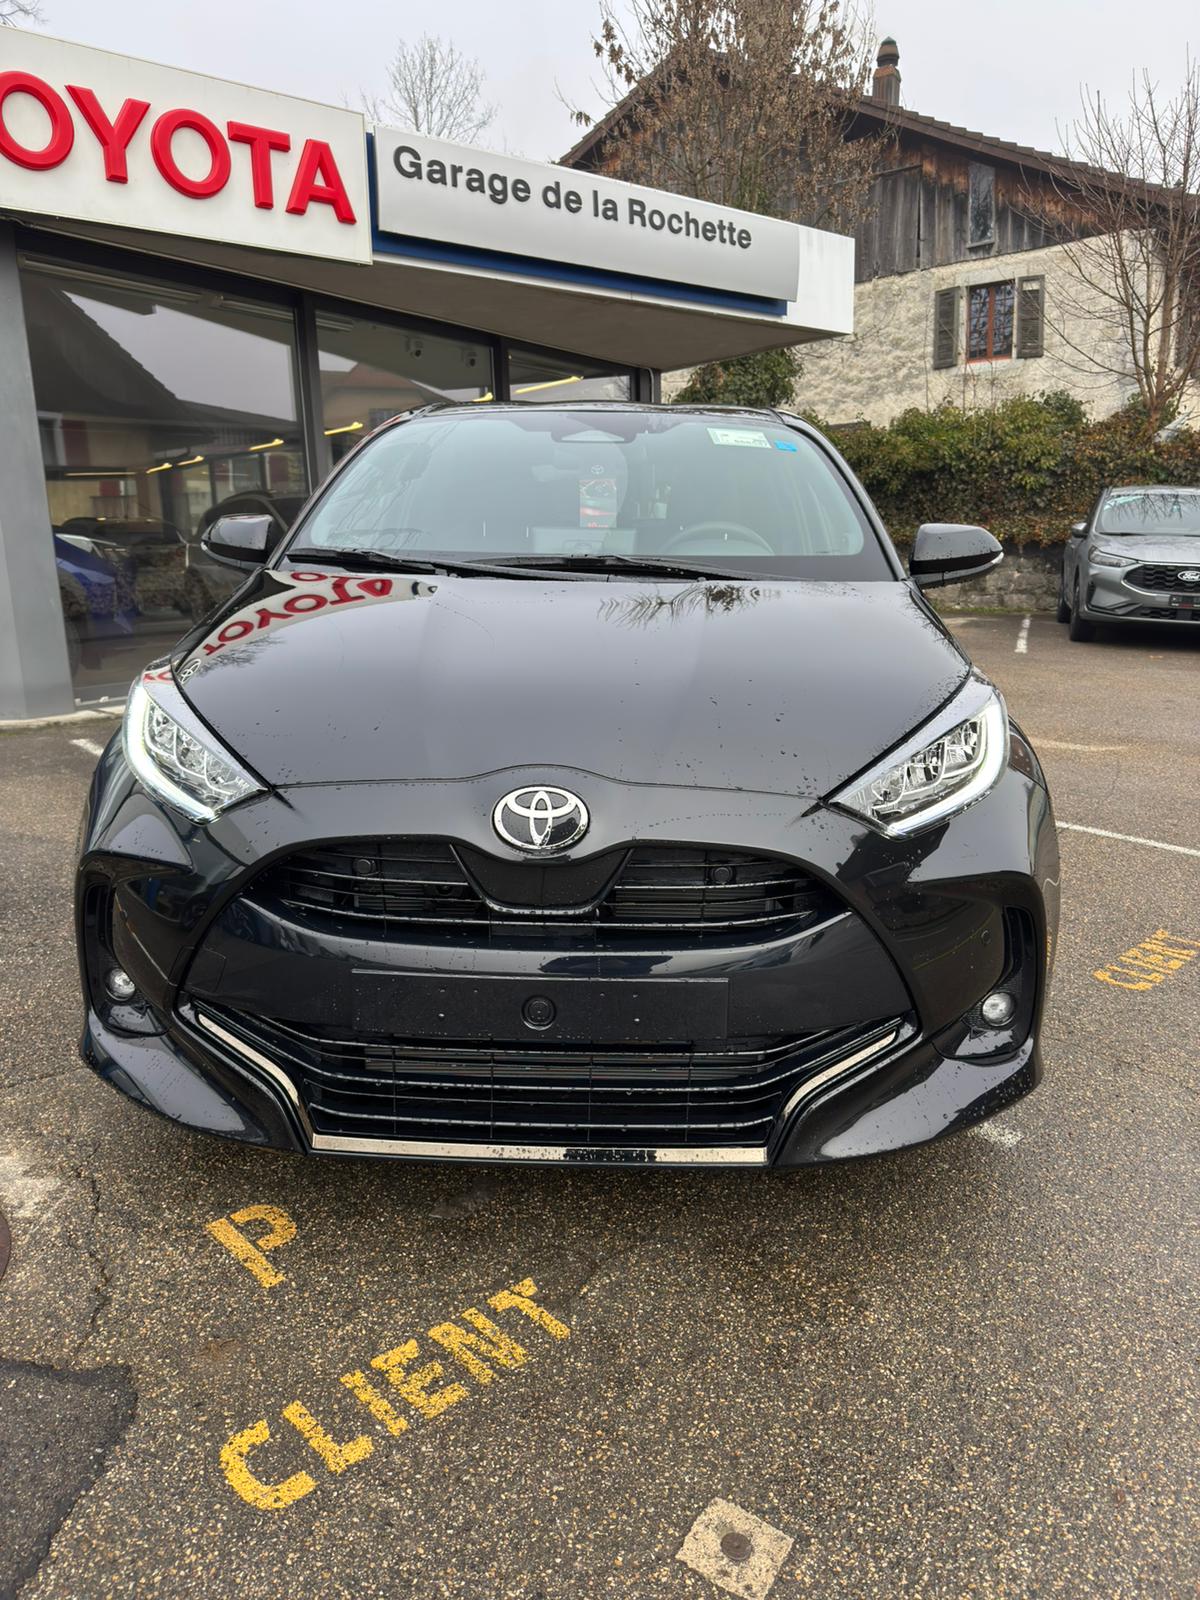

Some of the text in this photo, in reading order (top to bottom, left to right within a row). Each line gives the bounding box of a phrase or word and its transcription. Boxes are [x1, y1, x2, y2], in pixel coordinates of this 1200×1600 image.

[392, 144, 752, 249] Garage de la Rochette
[1093, 928, 1200, 991] CLIENT
[206, 1204, 297, 1288] P
[219, 1277, 570, 1509] CLIENT
